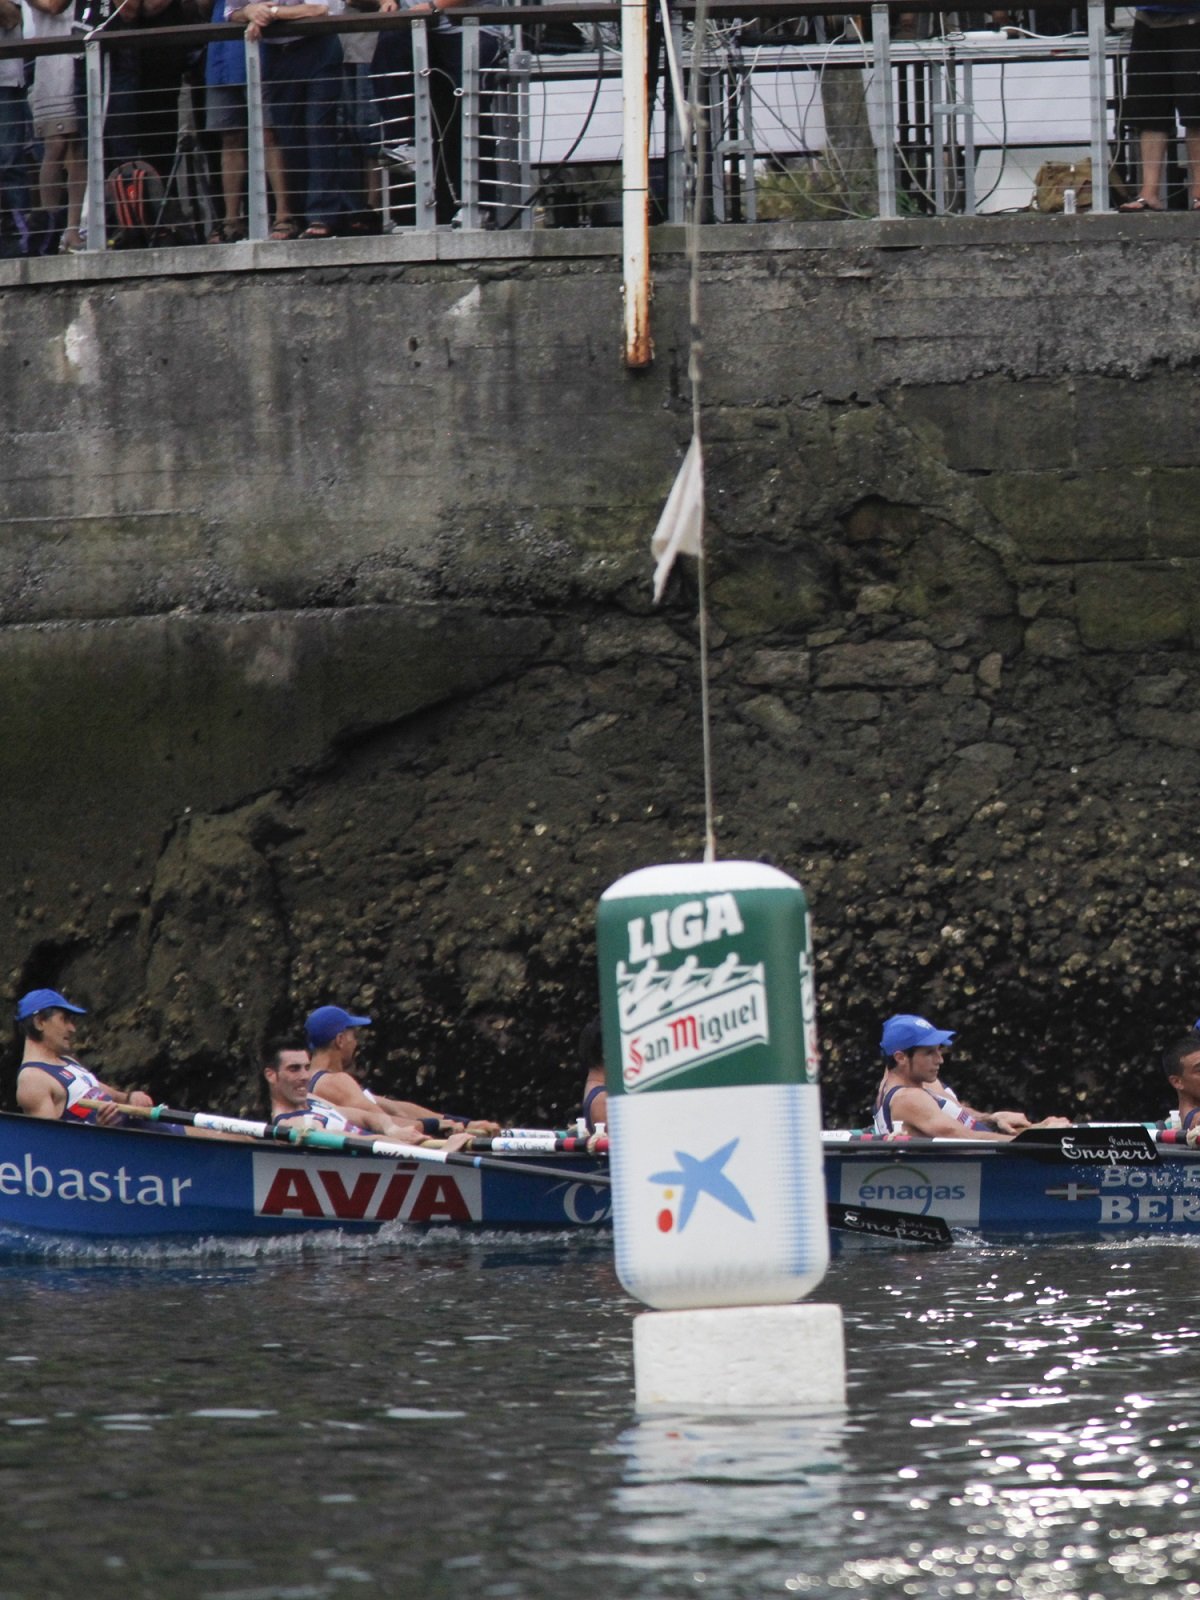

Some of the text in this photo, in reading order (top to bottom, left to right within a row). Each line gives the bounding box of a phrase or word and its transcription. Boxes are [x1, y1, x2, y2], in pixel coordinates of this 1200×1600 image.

[627, 893, 744, 964] LIGA
[623, 995, 757, 1081] San Miguel
[1061, 1136, 1157, 1165] Eneperi
[0, 1153, 192, 1207] ebastar
[858, 1184, 965, 1209] enagas
[1102, 1165, 1173, 1188] Bou
